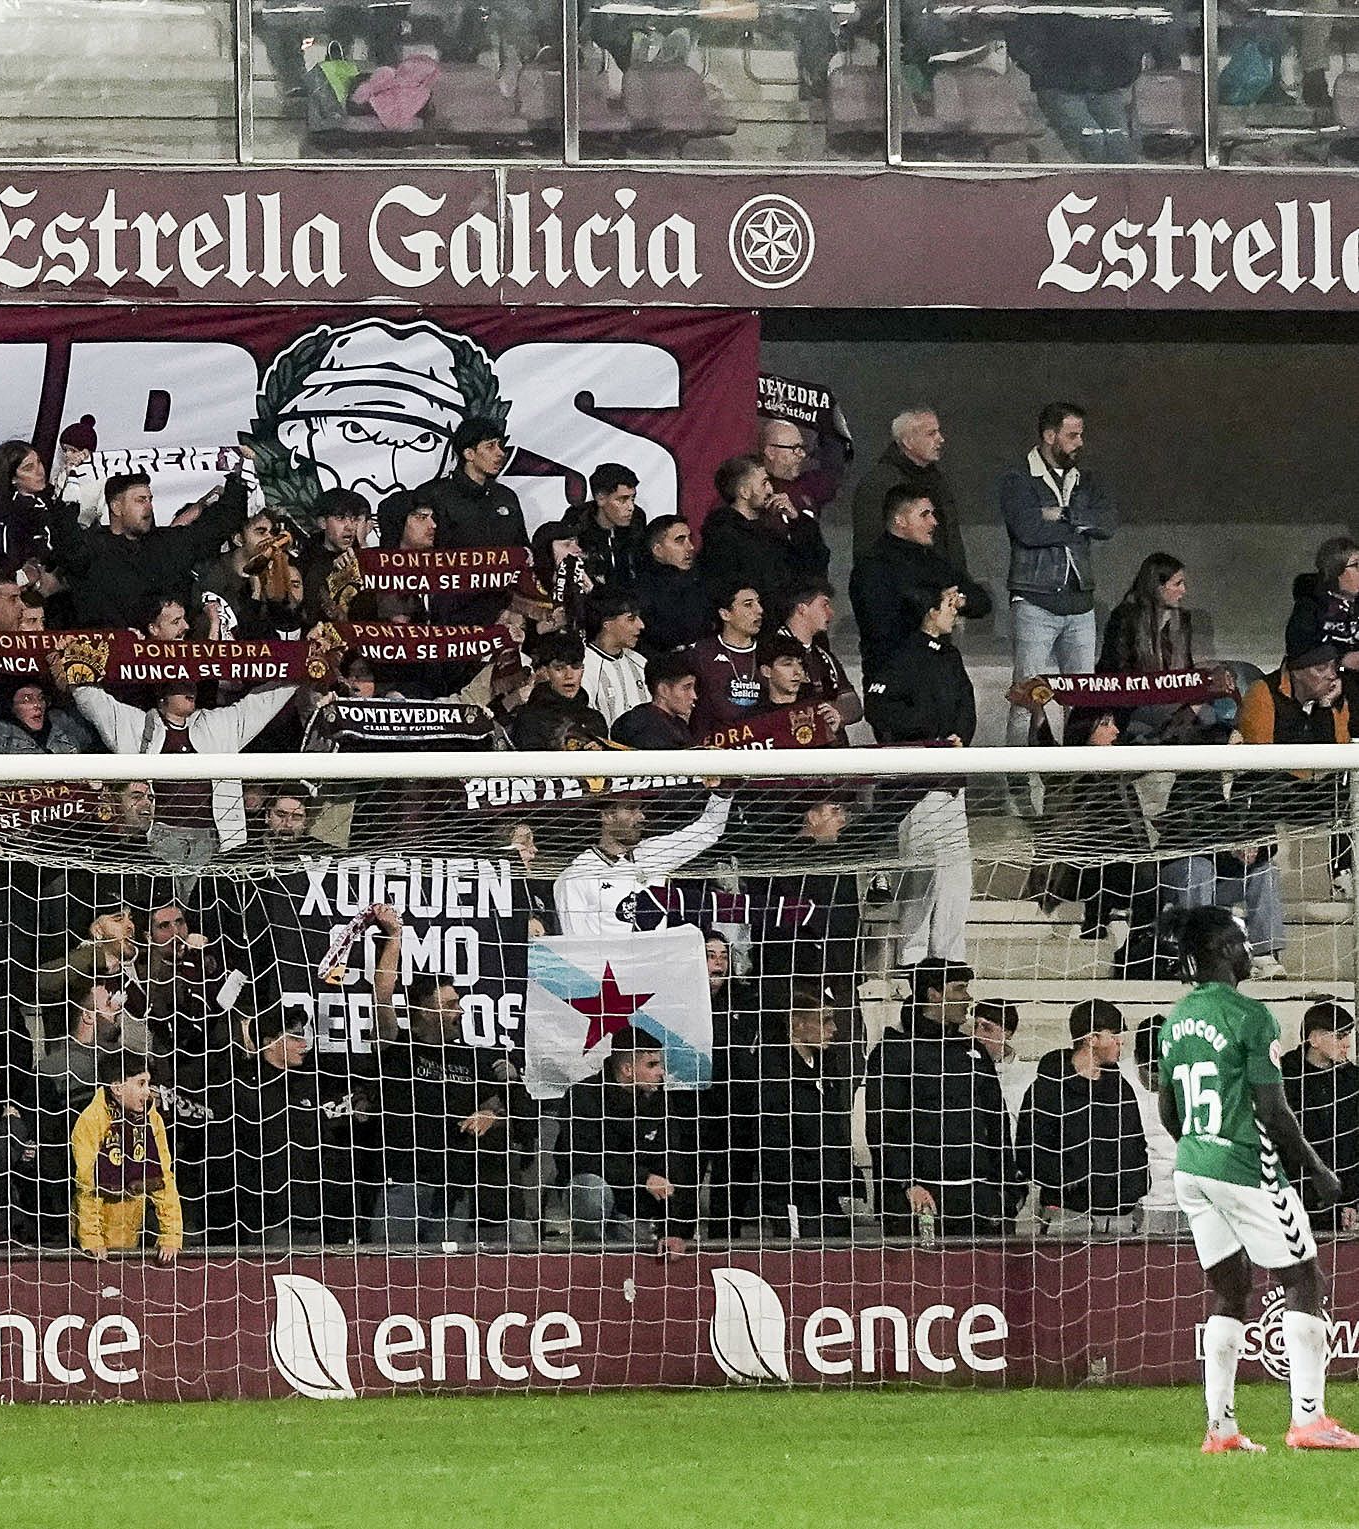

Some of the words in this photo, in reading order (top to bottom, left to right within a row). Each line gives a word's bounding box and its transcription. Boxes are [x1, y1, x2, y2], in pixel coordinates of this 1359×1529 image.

[368, 185, 702, 289] Galicia
[380, 551, 510, 568] PONTEVEDRA
[364, 574, 430, 590] NUNCA
[439, 575, 460, 590] SE
[470, 571, 522, 589] RINDE
[134, 643, 272, 658] PONTEVEDRA
[416, 643, 438, 659] SE
[447, 637, 505, 658] RINDE
[120, 663, 190, 681] NUNCA
[199, 662, 223, 678] SE
[231, 662, 290, 679] RINDE
[1047, 677, 1074, 690] NON
[1077, 676, 1122, 692] PARAR
[1125, 676, 1150, 691] ATA
[1154, 672, 1203, 689] VOLTAR
[730, 680, 761, 691] Estrella
[338, 706, 462, 724] PONTEVEDRA
[0, 812, 22, 829] SE
[30, 799, 85, 825] RINDE
[299, 855, 513, 918] XOGUEN
[1171, 1017, 1228, 1053] DIOCOU
[1172, 1061, 1223, 1136] 15
[373, 1311, 583, 1383] ence
[802, 1303, 1009, 1376] ence
